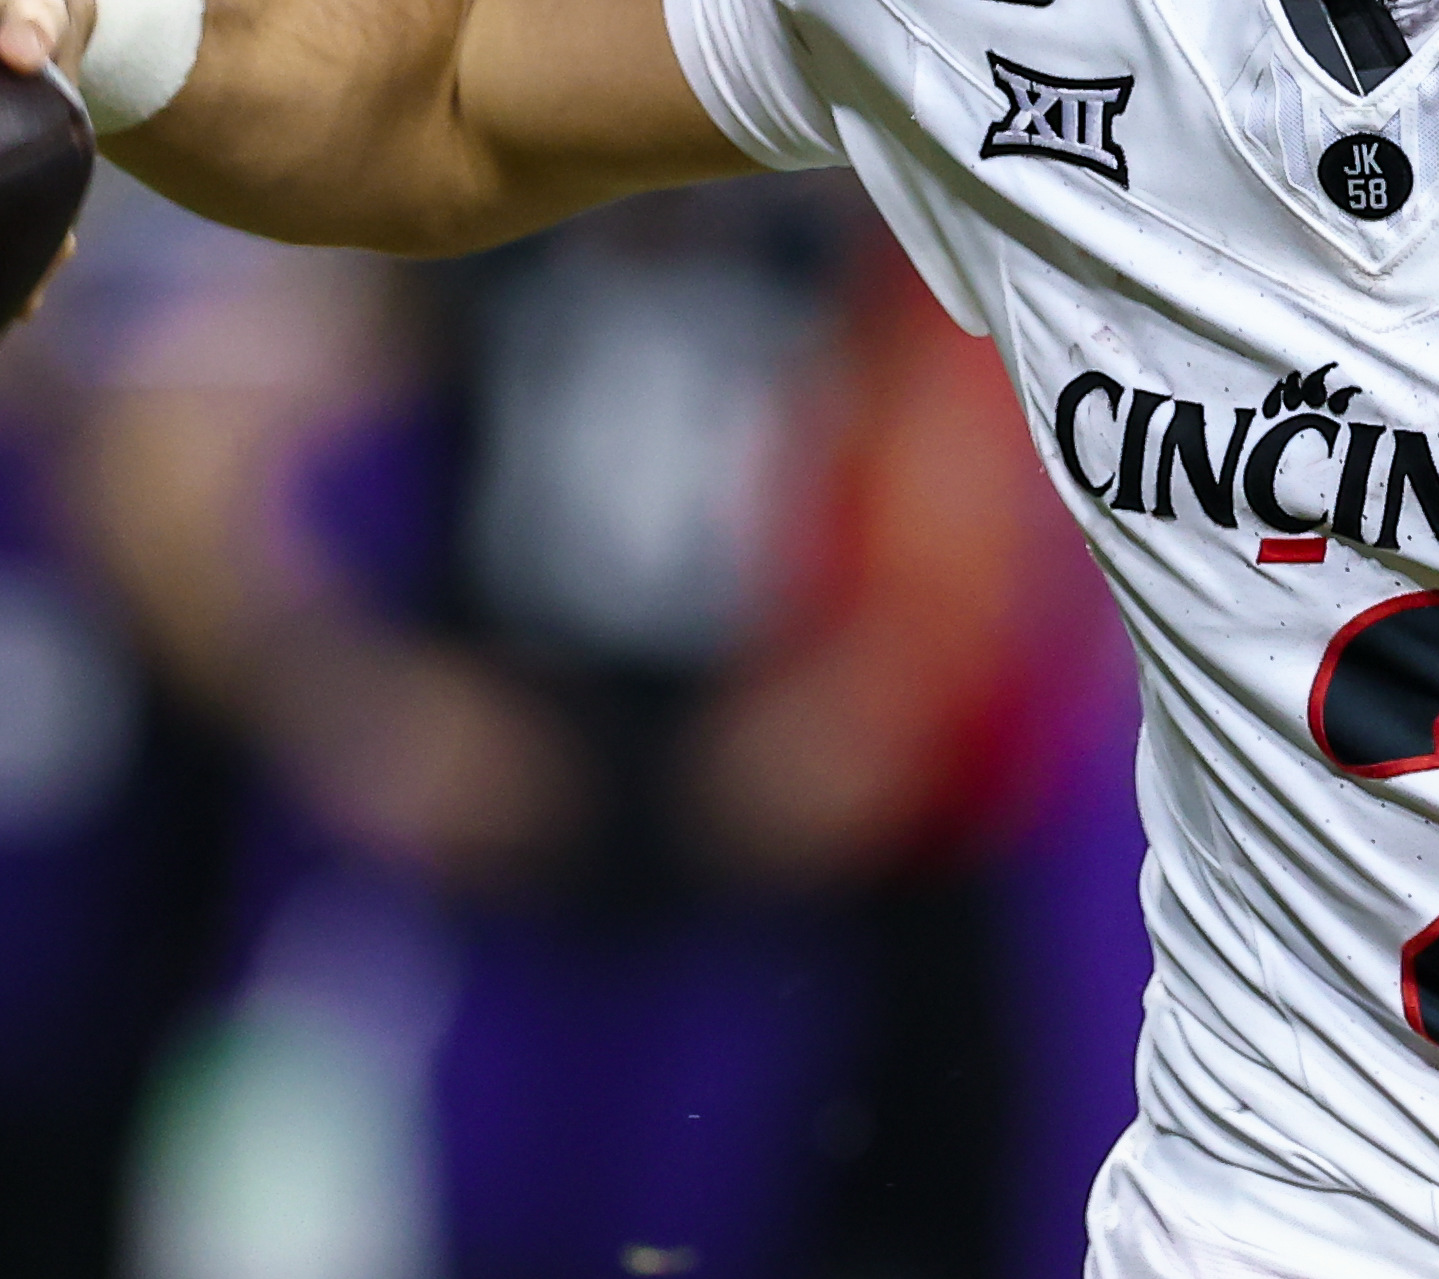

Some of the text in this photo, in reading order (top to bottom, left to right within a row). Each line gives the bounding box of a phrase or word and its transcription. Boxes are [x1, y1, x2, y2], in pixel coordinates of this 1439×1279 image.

[989, 61, 1124, 173] XII
[1343, 142, 1383, 175] JK
[1347, 178, 1388, 210] 58
